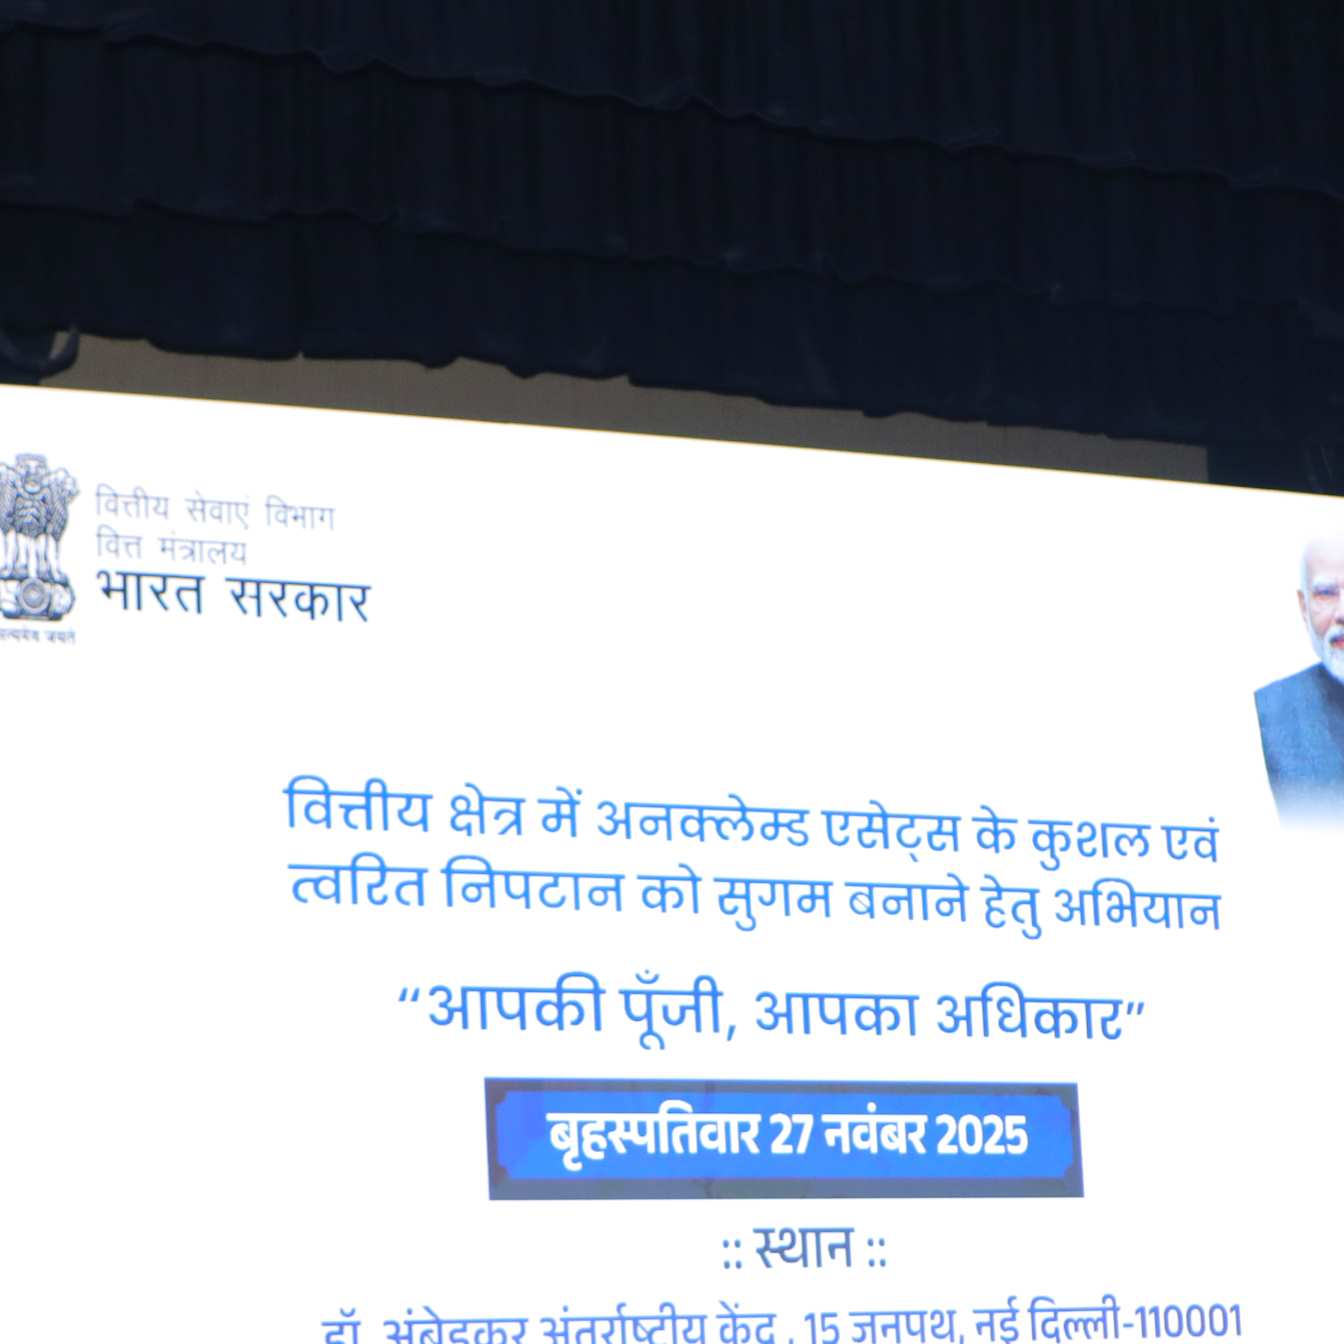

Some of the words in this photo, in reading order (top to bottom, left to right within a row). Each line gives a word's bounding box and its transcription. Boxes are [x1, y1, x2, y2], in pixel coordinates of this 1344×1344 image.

[95, 483, 170, 520] वित्तीय
[185, 490, 250, 530] सेवाएं
[265, 495, 336, 530] विभाग
[96, 524, 142, 559] वित्त
[159, 530, 248, 565] मंत्रालय
[96, 570, 205, 614] भारत
[225, 577, 372, 622] सरकार
[283, 774, 433, 834] वित्तीय
[450, 782, 525, 839] क्षेत्र
[540, 785, 584, 839] में
[596, 791, 811, 849] अनक्लेम्ड
[820, 799, 962, 865] एसेट्स
[972, 804, 1018, 855] के
[1031, 812, 1152, 871] कुशल
[1163, 815, 1222, 865] एवं
[288, 850, 428, 909] त्वरित
[442, 854, 624, 914] निपटान
[640, 863, 701, 917] को
[715, 878, 833, 933] सुगम
[846, 873, 969, 925] बनाने
[981, 878, 1043, 940] हेतु
[1054, 878, 1223, 933] अभियान
[398, 970, 605, 1034] “आपकी
[619, 968, 737, 1051] पूँजी,
[754, 989, 920, 1038] आपका
[936, 980, 1145, 1043] अधिकार”
[547, 1100, 762, 1172] बृहस्पतिवार
[769, 1114, 815, 1155] 27
[822, 1101, 928, 1155] नवंबर
[935, 1114, 1029, 1155] 2025
[753, 1225, 855, 1271] स्थान
